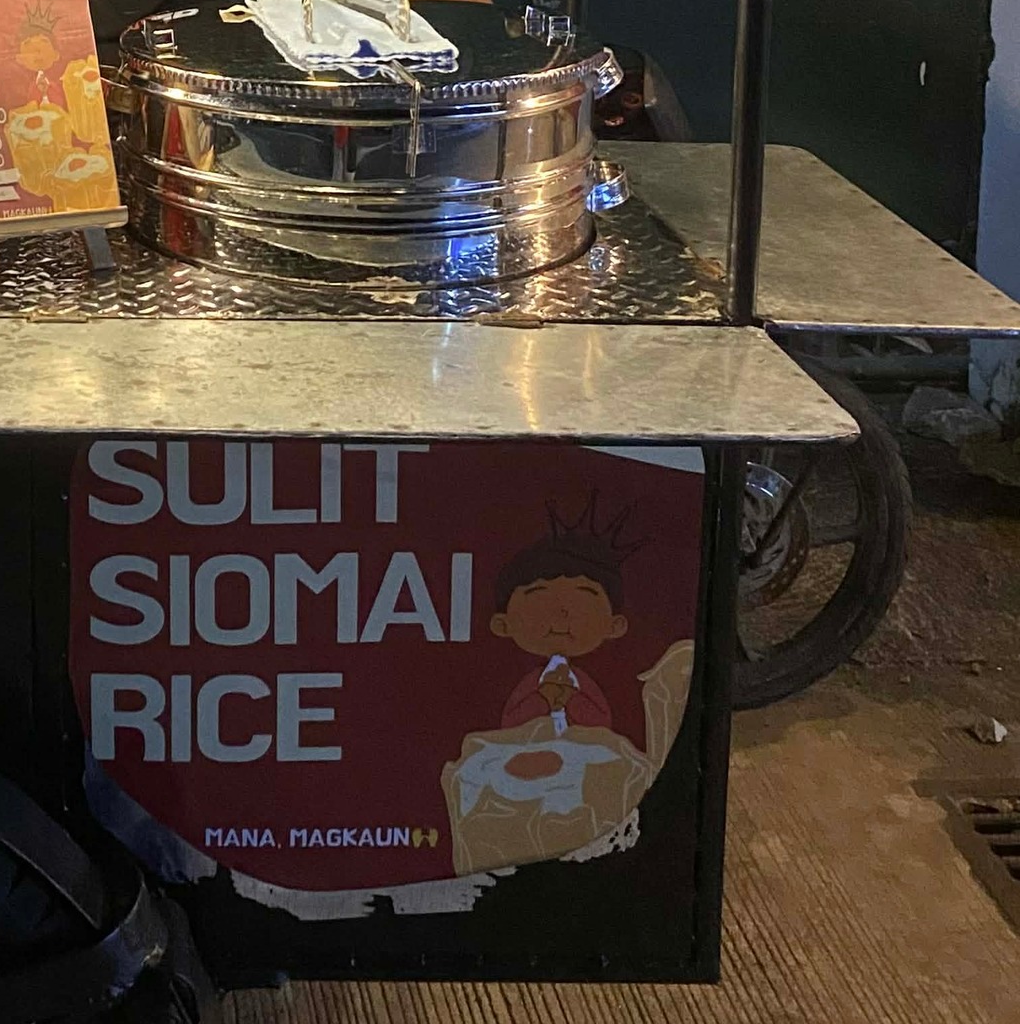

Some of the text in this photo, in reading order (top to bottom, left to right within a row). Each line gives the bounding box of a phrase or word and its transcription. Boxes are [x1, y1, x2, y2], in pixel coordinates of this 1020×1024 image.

[86, 439, 431, 525] SULIT
[89, 551, 474, 647] SIOMAI
[89, 672, 344, 764] RICE
[289, 827, 410, 848] MAGKAUN
